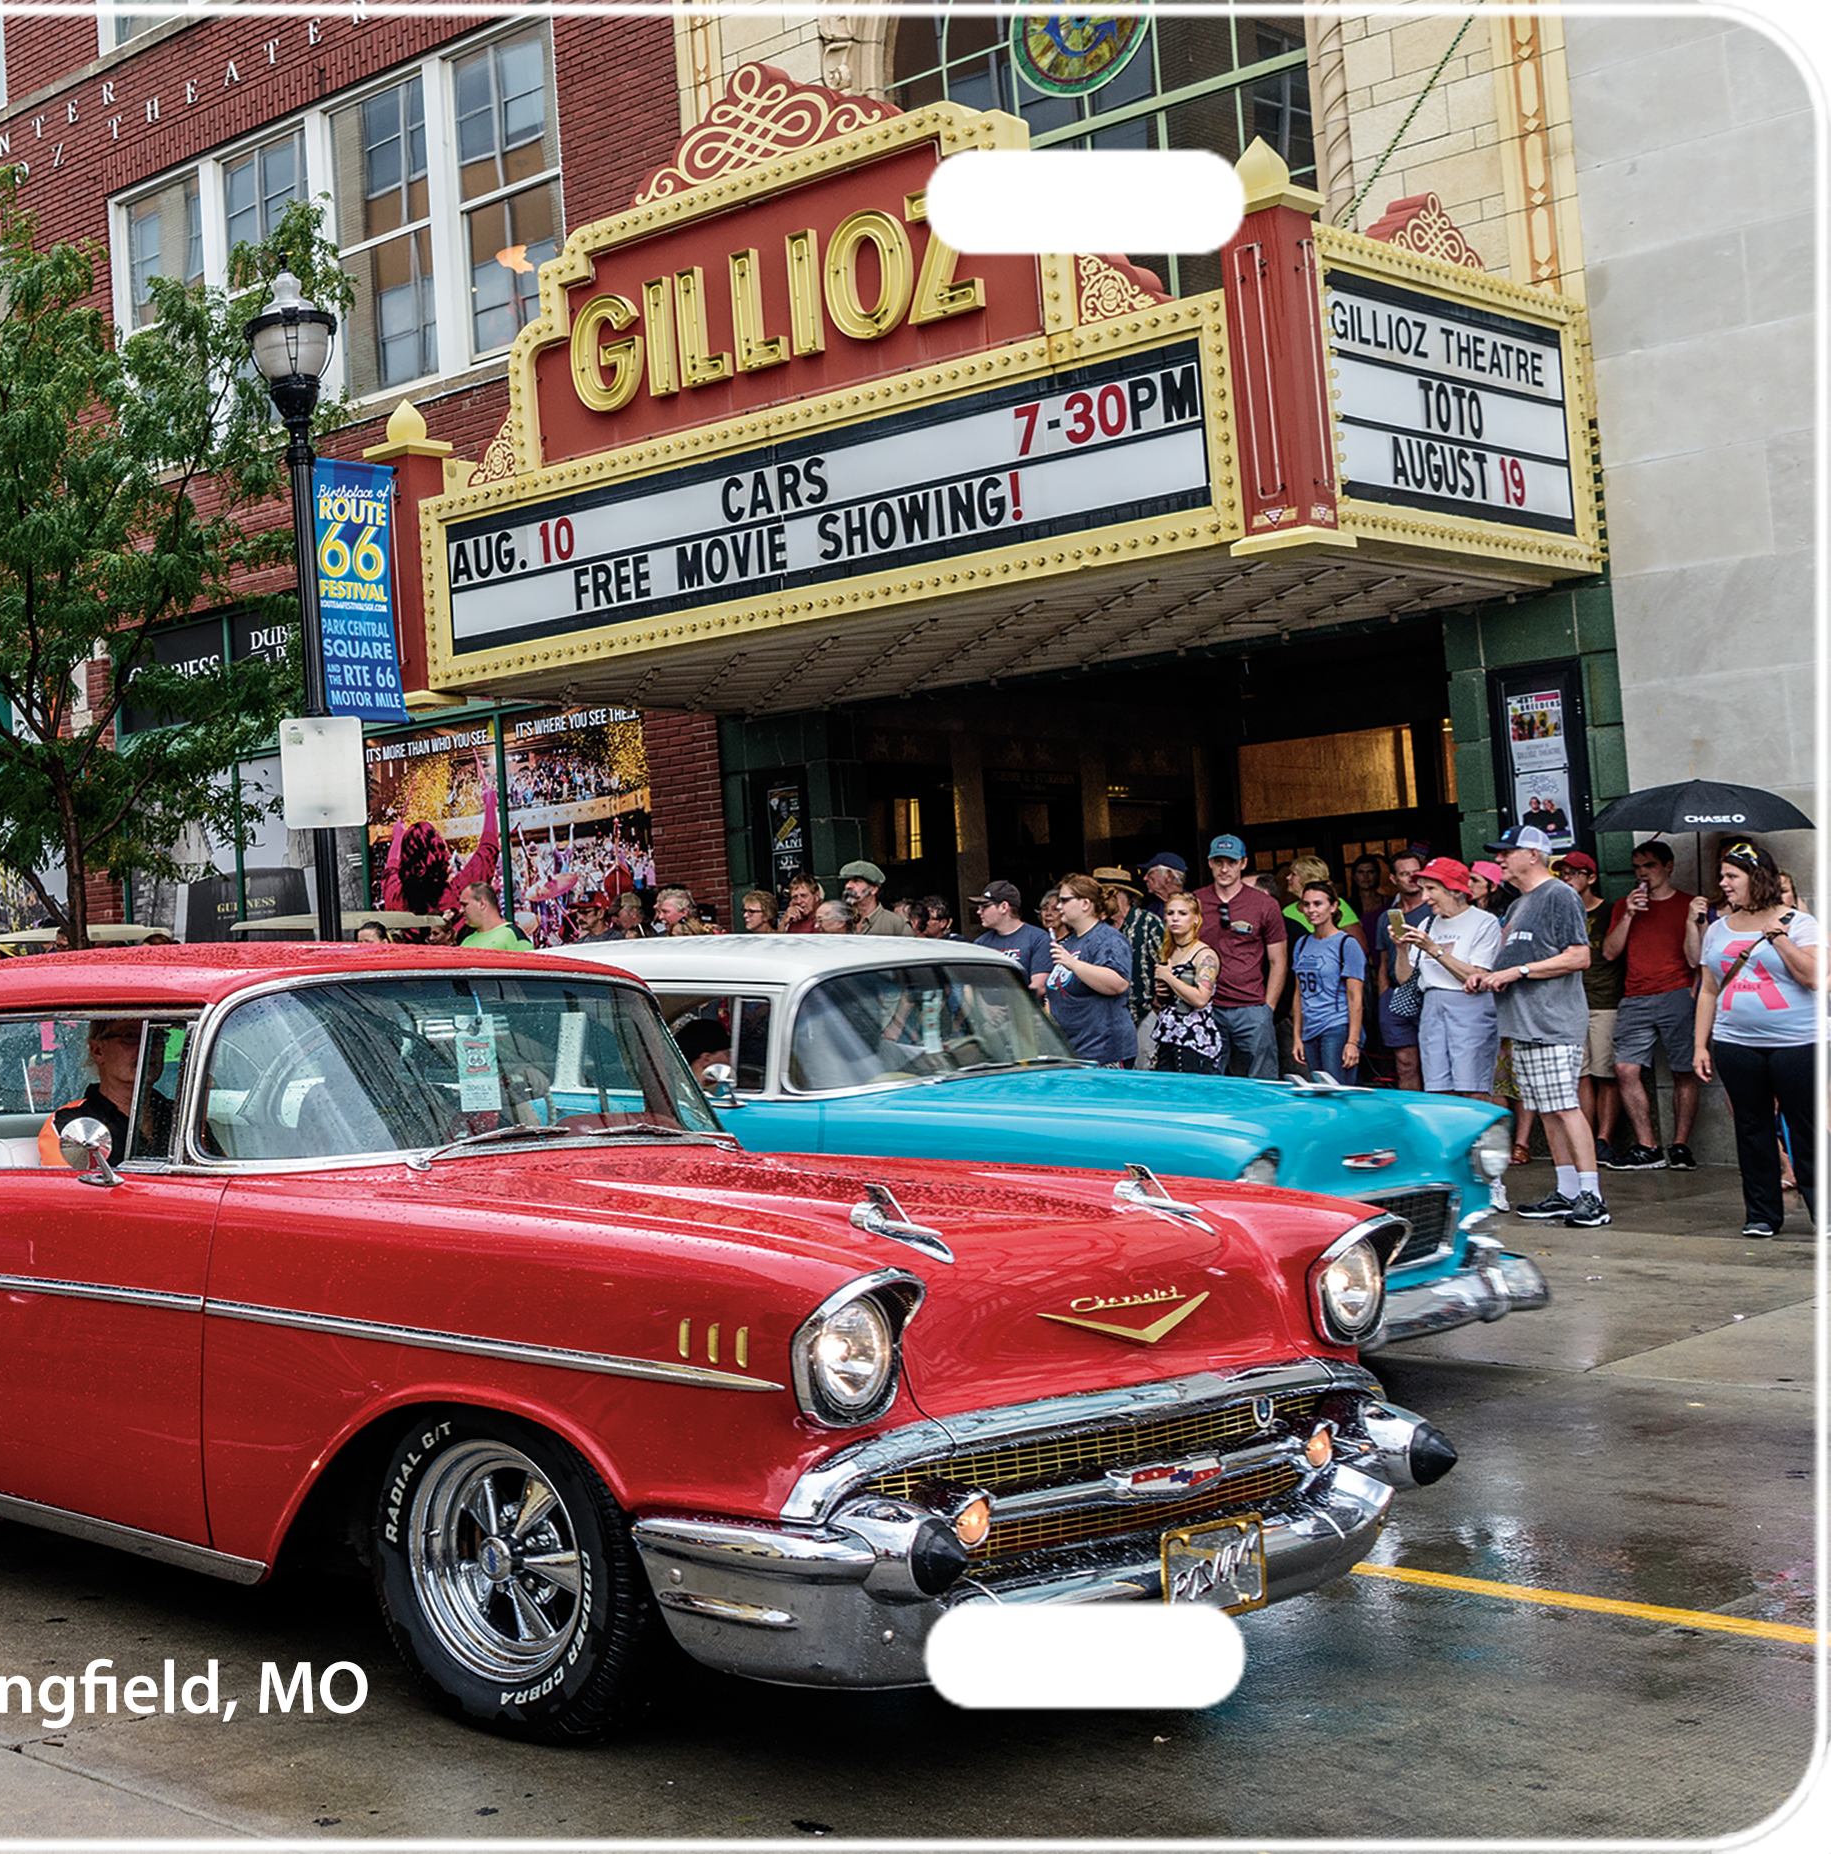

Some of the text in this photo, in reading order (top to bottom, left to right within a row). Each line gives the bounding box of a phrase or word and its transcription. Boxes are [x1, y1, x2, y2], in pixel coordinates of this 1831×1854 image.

[107, 0, 368, 141] THEATER
[570, 190, 986, 412] GILLIOZ
[1331, 299, 1544, 388] GILLIOZ THEATRE
[1418, 377, 1485, 439] TOTO
[1392, 435, 1527, 508] AUGUST 19
[317, 484, 389, 502] Birthplace of
[319, 497, 386, 526] ROUTE
[452, 456, 829, 585] AUG. 10 CARS
[318, 522, 386, 581] 66
[574, 471, 1023, 612] FREE MOVIE SHOWING!
[320, 580, 388, 602] FESTIVAL
[322, 618, 389, 638] PARK CENTRAL
[323, 638, 393, 660] SQUARE
[327, 664, 341, 673] AND
[328, 664, 396, 688] THE RTE 66
[331, 690, 401, 708] MOTOR MILE
[516, 721, 532, 738] IT'S
[535, 715, 567, 736] WHERE
[568, 711, 587, 729] YOU
[589, 708, 607, 726] SEE
[366, 749, 381, 763] IT'S
[383, 744, 406, 761] MORE
[408, 739, 430, 757] THAN
[431, 737, 451, 753] WHO
[453, 732, 469, 750] YOU
[1684, 814, 1731, 823] CHASE
[217, 896, 276, 913] GUINESS
[1297, 972, 1317, 993] 66
[1070, 1285, 1187, 1313] Chevrolet
[385, 1421, 452, 1543] RADIAL G/T
[500, 1666, 564, 1705] COBRA
